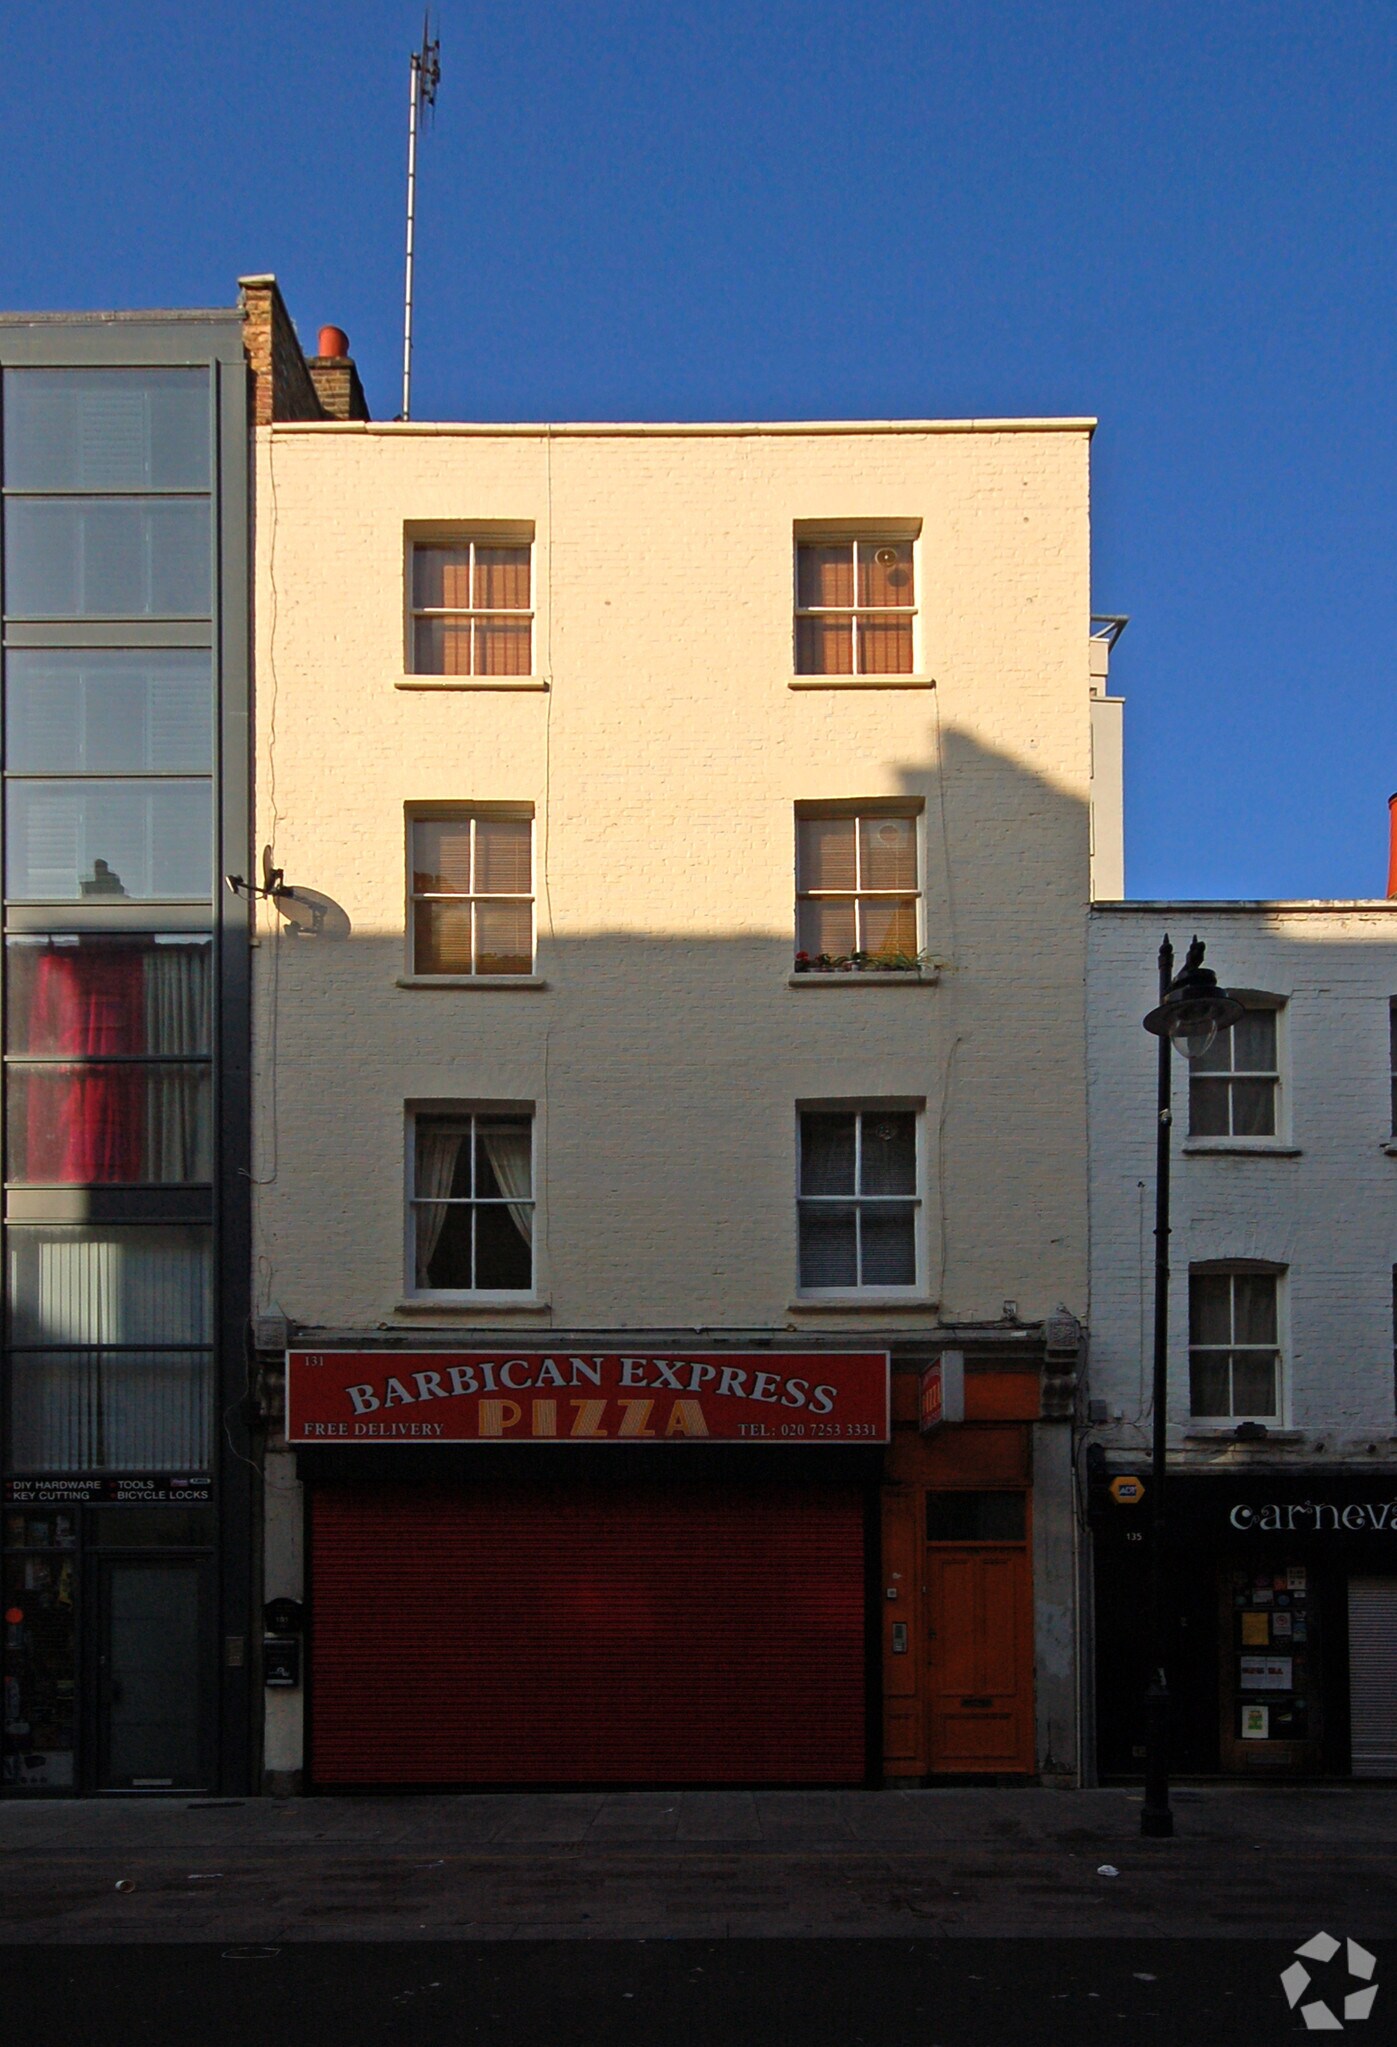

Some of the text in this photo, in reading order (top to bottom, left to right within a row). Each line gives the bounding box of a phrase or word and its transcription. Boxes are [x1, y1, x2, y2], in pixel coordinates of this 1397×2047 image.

[304, 1356, 324, 1367] 131
[345, 1357, 838, 1416] BARBICAN EXPRESS
[478, 1399, 710, 1437] PIZZA
[303, 1422, 444, 1436] FREE DELIVERY
[738, 1423, 877, 1437] TEL: 020 7253 3331
[13, 1480, 102, 1490] DIY HARDWARE
[117, 1480, 155, 1490] TOOLS
[13, 1491, 91, 1500] KEY CUTTING
[117, 1490, 209, 1500] BICYCLE LOCKS
